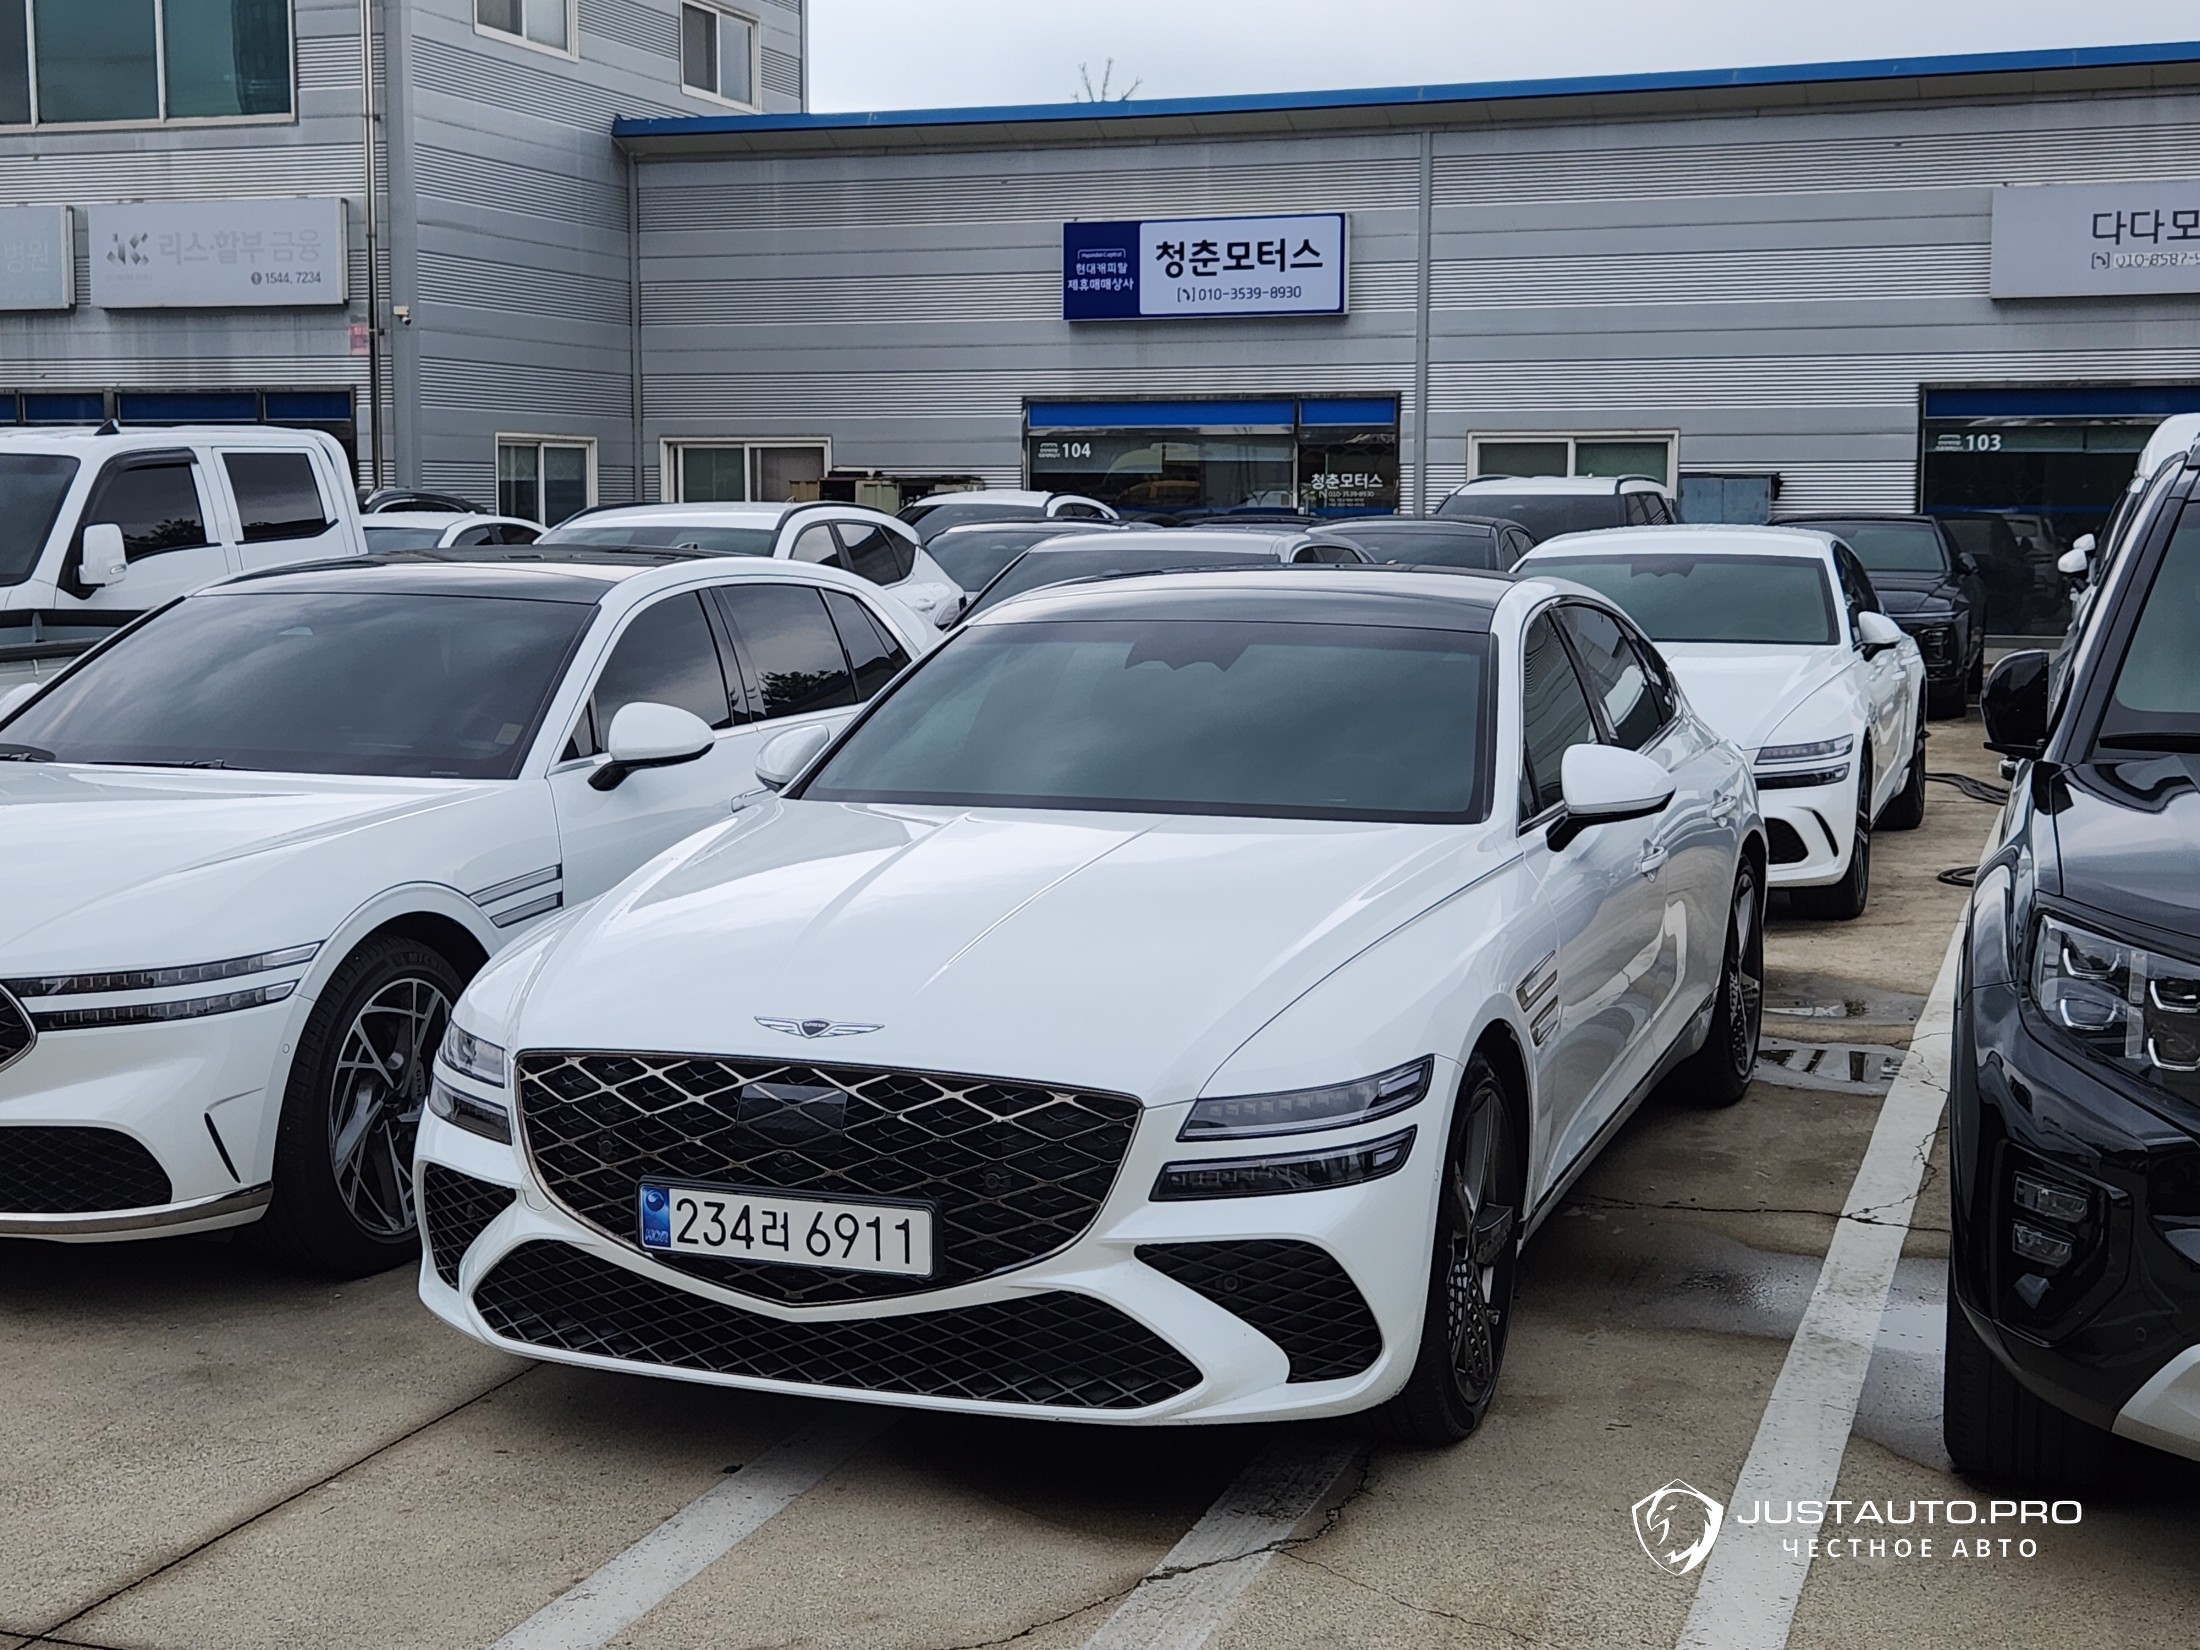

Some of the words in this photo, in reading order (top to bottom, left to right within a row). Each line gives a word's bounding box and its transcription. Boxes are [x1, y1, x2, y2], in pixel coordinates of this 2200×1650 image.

[2092, 209, 2200, 246] 다다모
[270, 229, 322, 263] 금융
[0, 239, 50, 274] 병원
[1155, 238, 1323, 279] 청춘모터스
[1075, 262, 1129, 276] 현대캐피탈
[1067, 277, 1134, 292] 제휴매매상사
[1199, 286, 1302, 301] 010-3539-8930
[1062, 442, 1091, 459] 104
[1965, 434, 2002, 452] 103
[1310, 473, 1384, 490] 청춘모터스
[676, 1198, 790, 1252] 234러
[805, 1211, 911, 1265] 6911
